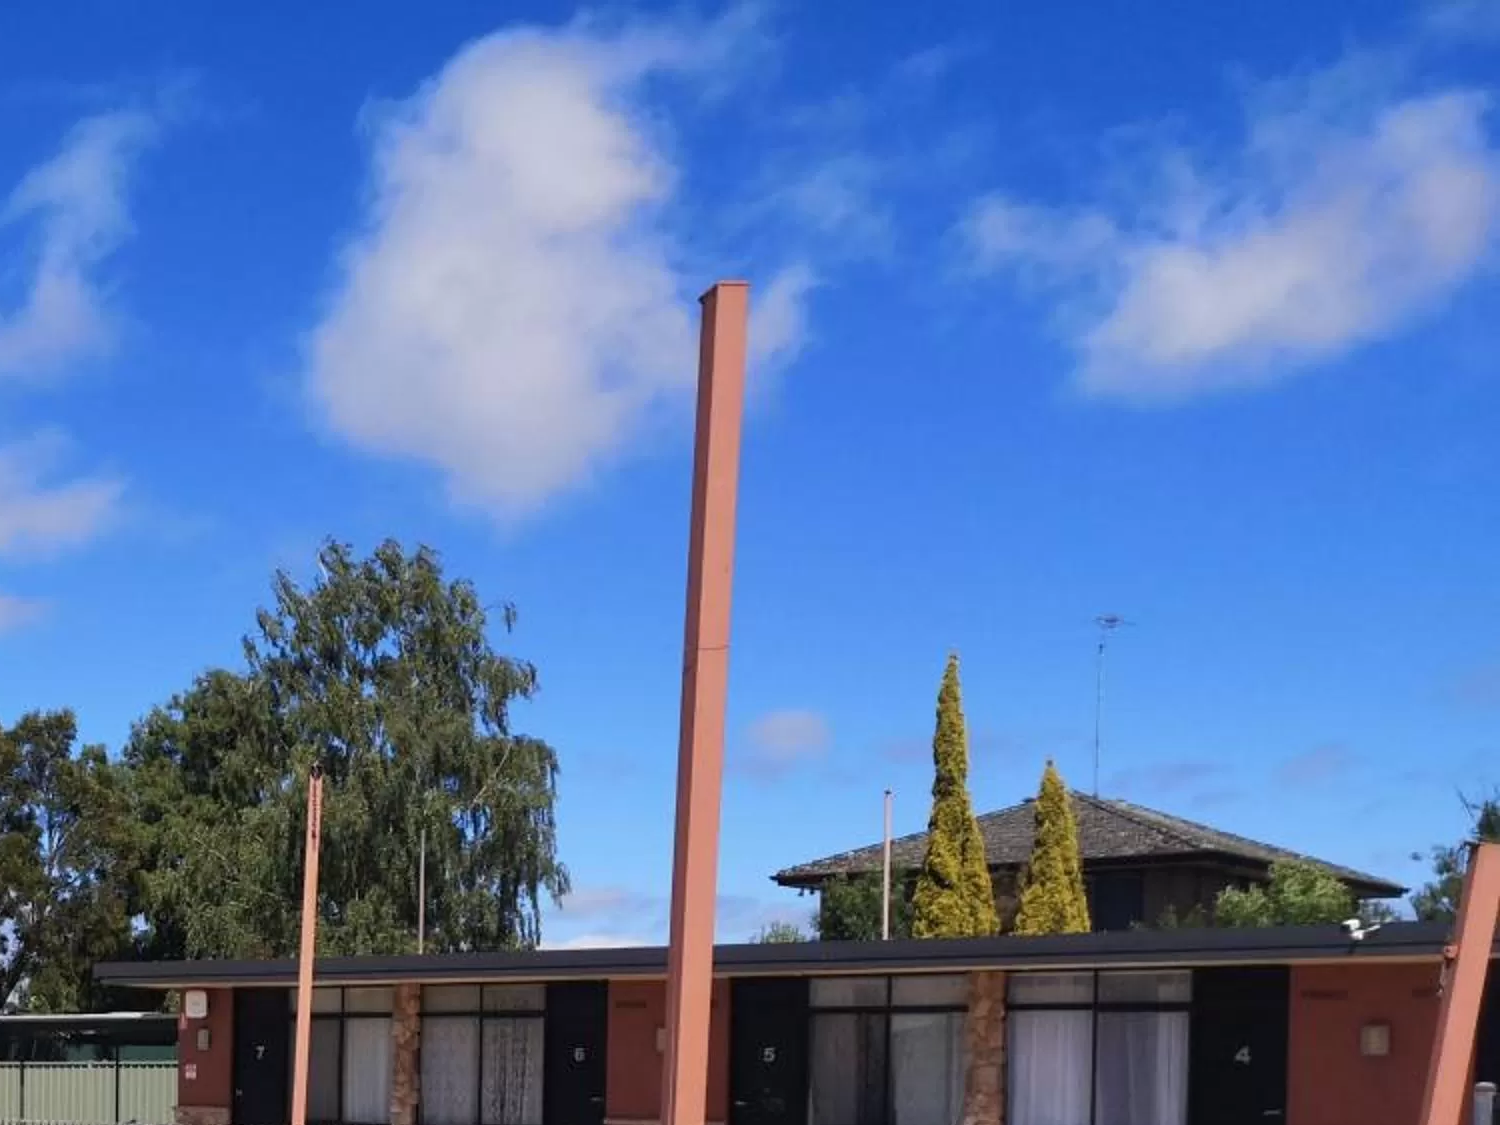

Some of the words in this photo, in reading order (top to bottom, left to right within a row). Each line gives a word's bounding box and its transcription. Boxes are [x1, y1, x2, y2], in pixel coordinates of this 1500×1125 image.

[255, 1045, 265, 1061] 7
[763, 1047, 776, 1062] 5
[1234, 1046, 1250, 1065] 4
